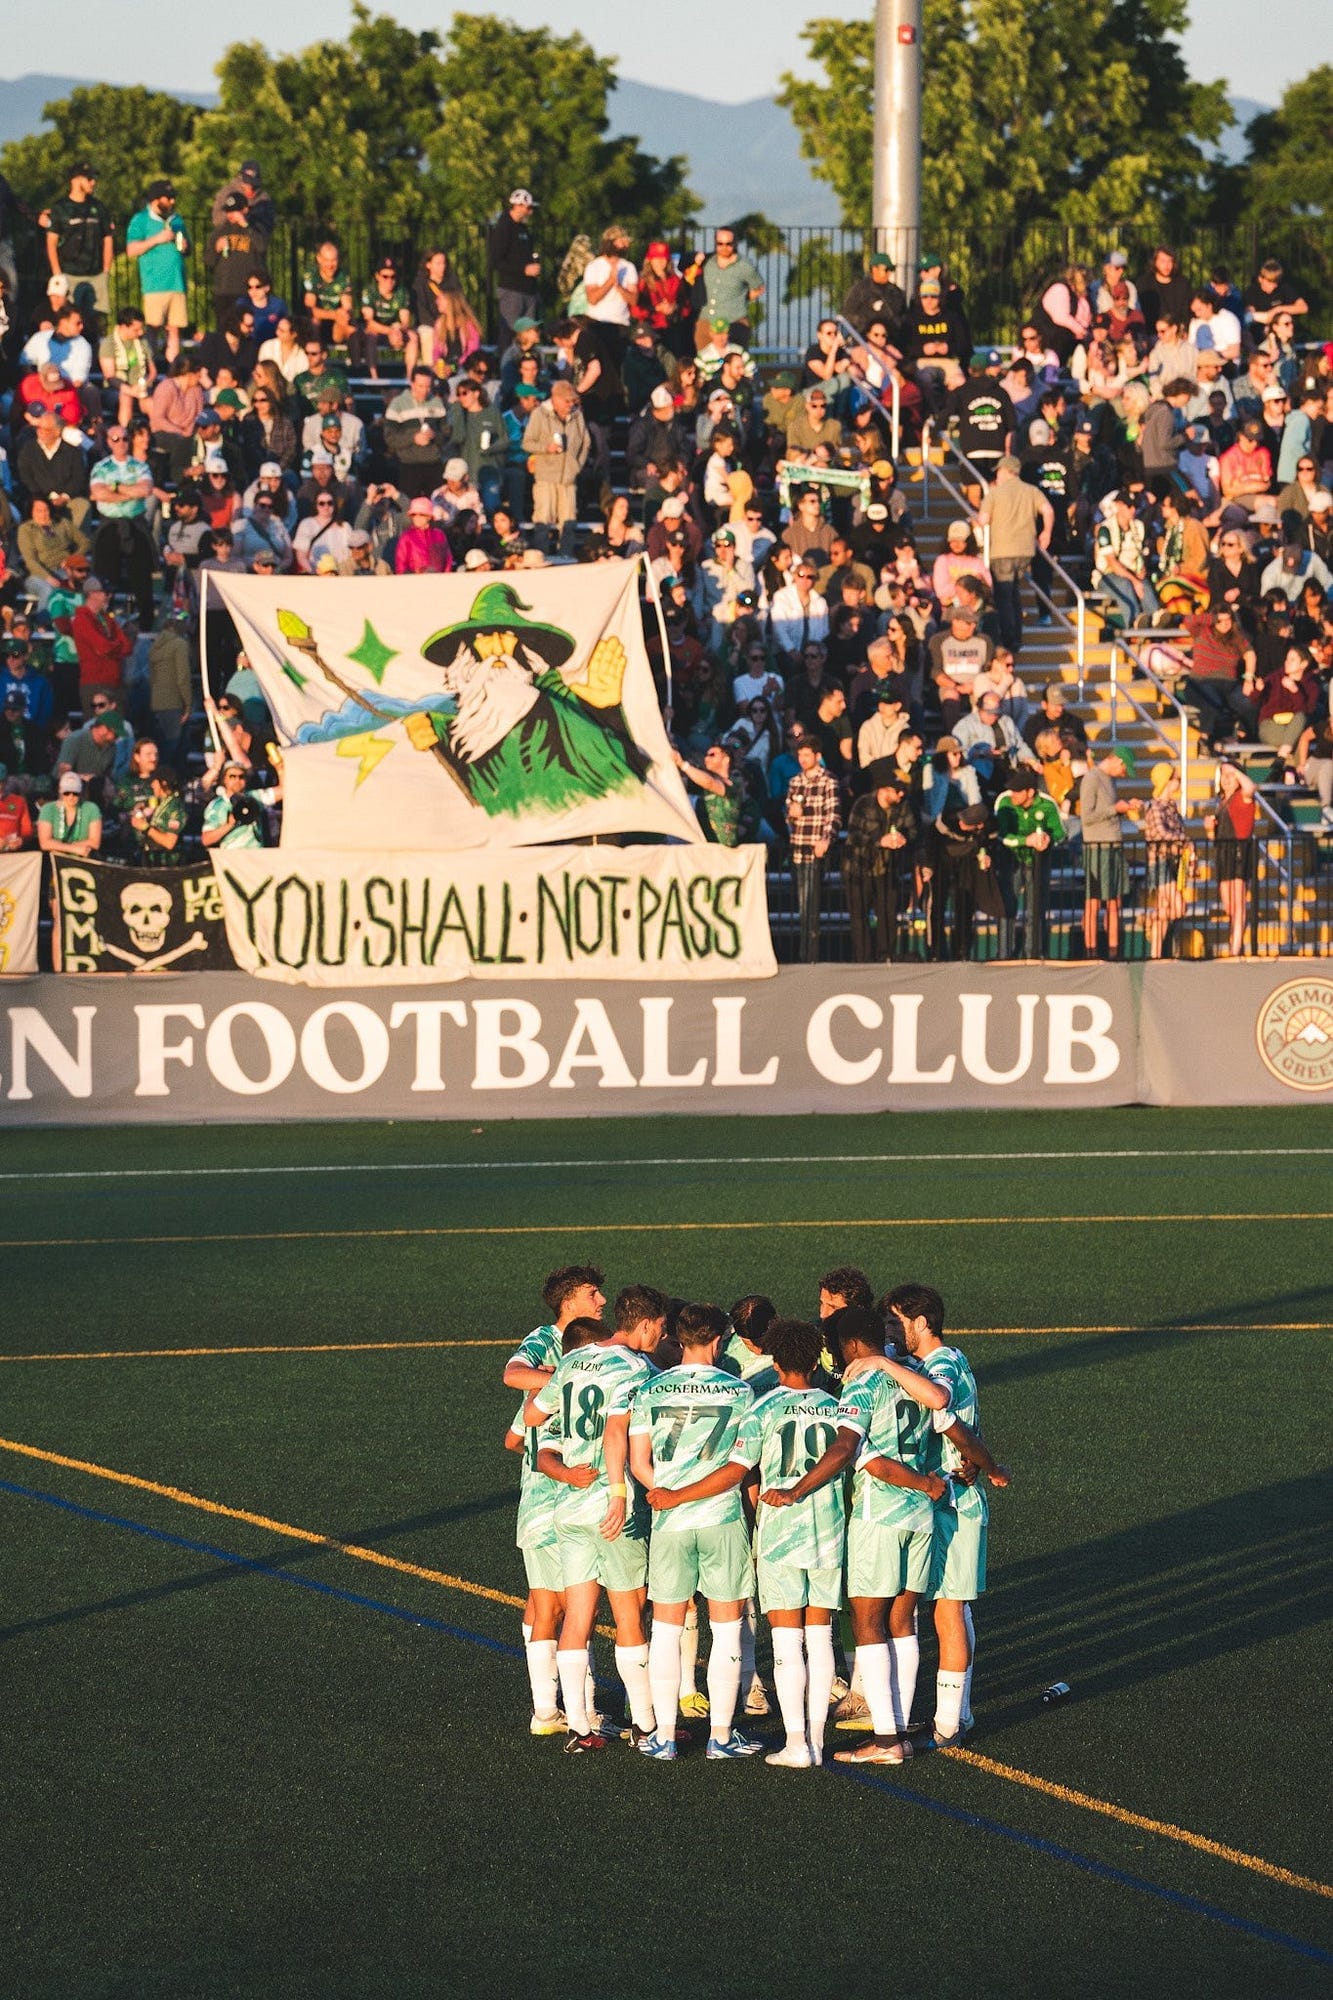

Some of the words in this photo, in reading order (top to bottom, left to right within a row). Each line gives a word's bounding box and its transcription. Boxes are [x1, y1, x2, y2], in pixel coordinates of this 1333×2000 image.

[223, 869, 347, 969] YOU
[364, 876, 525, 967] SHALL
[537, 871, 629, 963] NOT
[637, 875, 742, 961] PASS
[134, 996, 780, 1096] FOOTBALL
[806, 993, 1120, 1085] CLUB
[562, 1381, 604, 1441] 18
[648, 1383, 740, 1397] LOCKERMANN
[783, 1405, 832, 1417] ZENGUE
[650, 1405, 733, 1462] 77
[776, 1420, 838, 1478] 19
